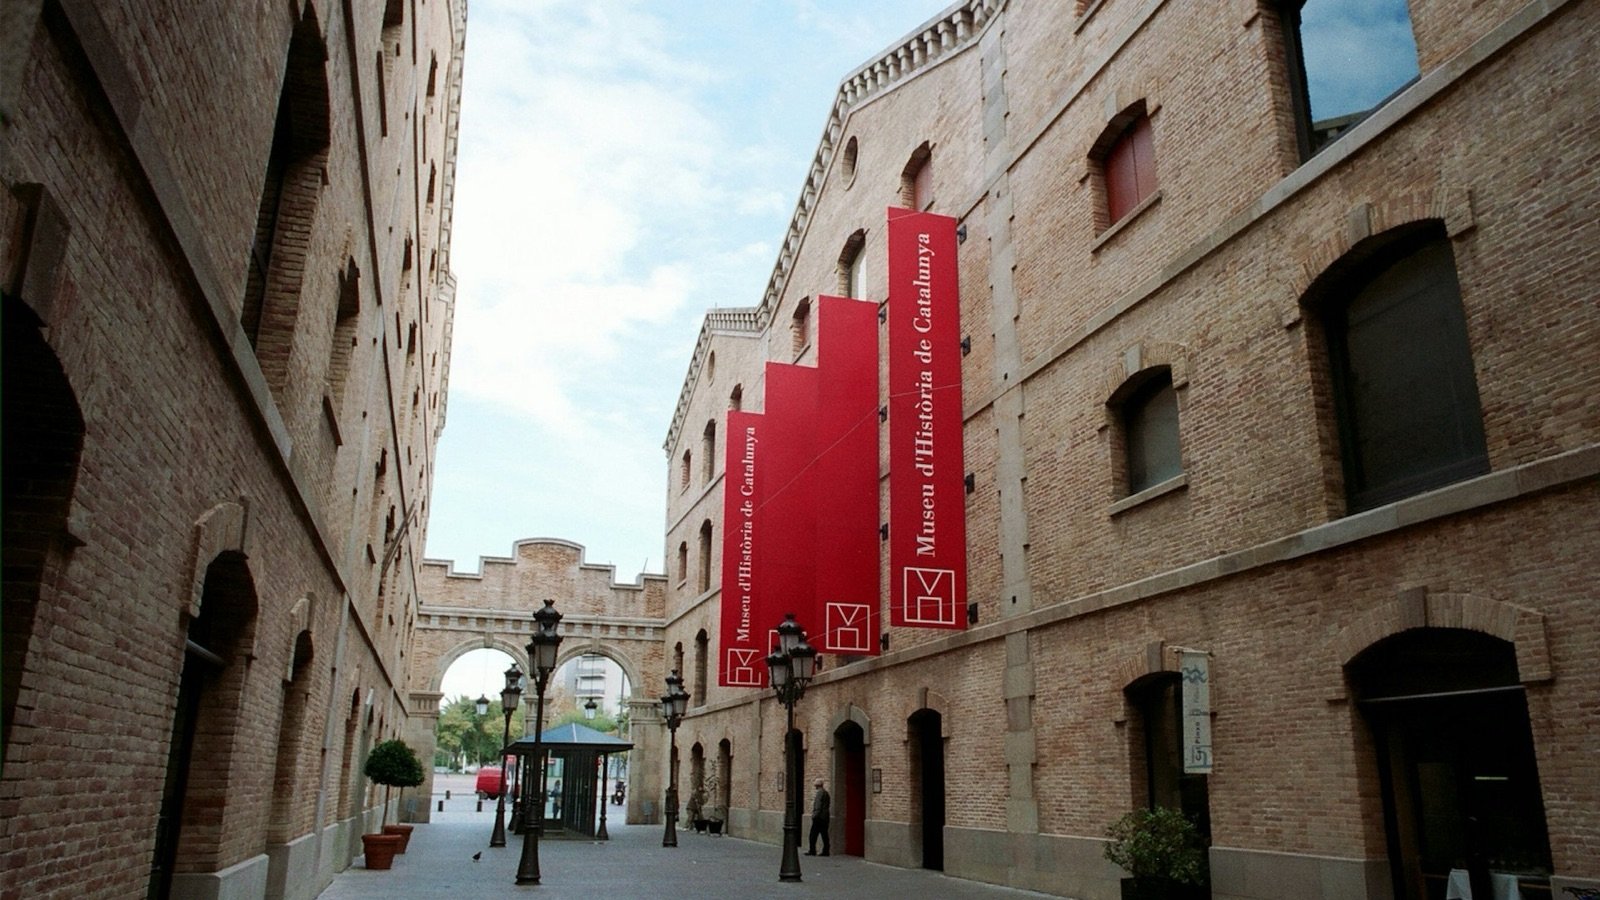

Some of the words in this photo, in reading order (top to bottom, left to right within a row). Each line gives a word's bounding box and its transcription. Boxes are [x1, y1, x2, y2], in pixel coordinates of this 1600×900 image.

[912, 232, 936, 334] Catalunya
[911, 339, 933, 364] de
[913, 371, 934, 477] d'Història
[741, 427, 758, 497] Catalunya
[740, 501, 753, 517] de
[914, 485, 935, 557] Museu
[739, 521, 753, 591] d'Història
[736, 595, 750, 641] Museu
